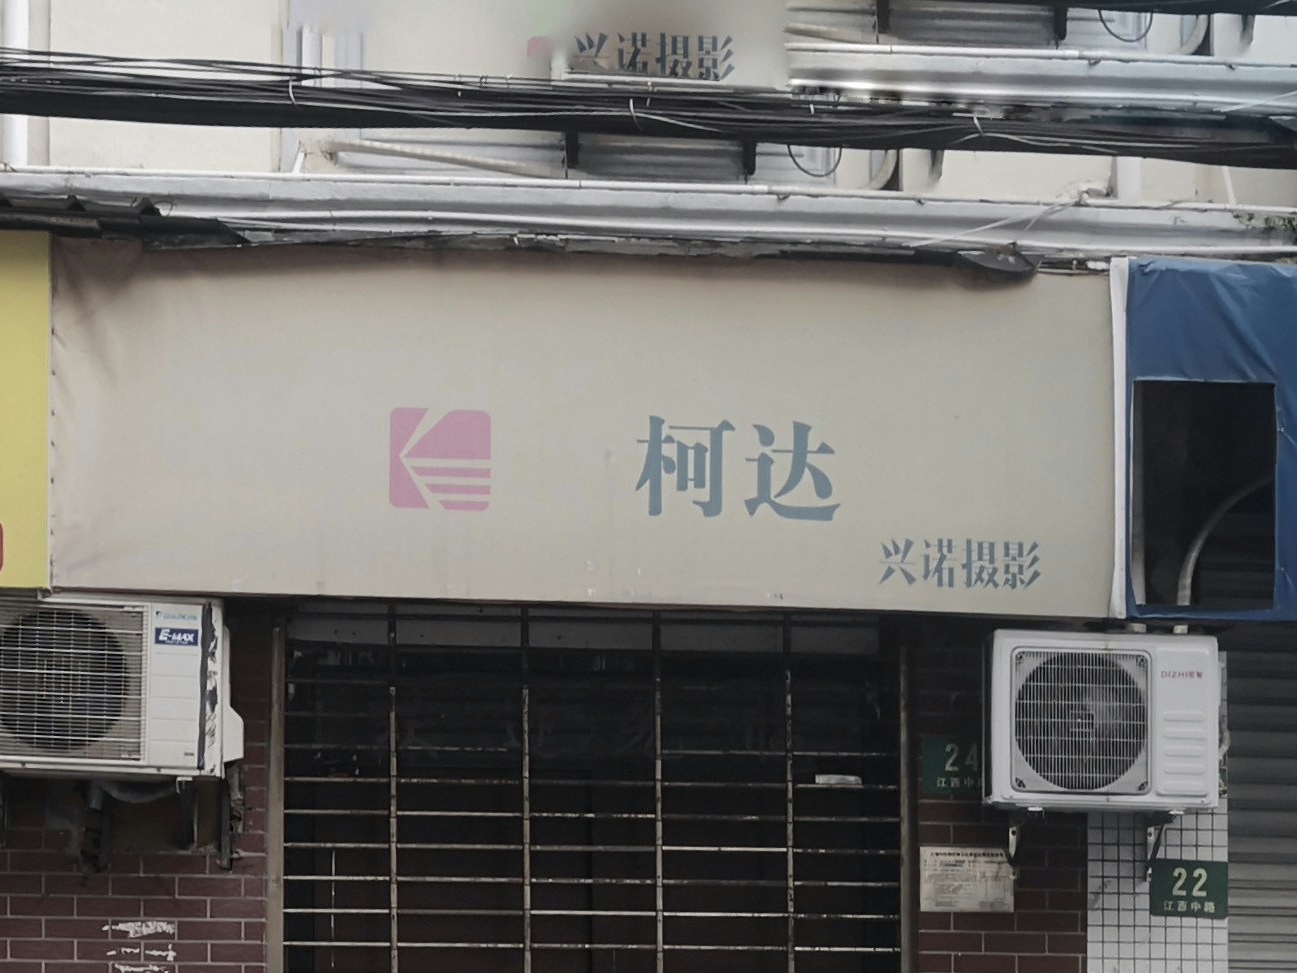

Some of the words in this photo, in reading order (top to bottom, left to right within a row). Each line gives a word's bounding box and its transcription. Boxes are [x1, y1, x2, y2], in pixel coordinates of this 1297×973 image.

[635, 416, 841, 522] 柯达
[878, 538, 1041, 590] 兴诺摄影
[1172, 867, 1208, 897] 22
[1163, 900, 1215, 913] 江西中路
